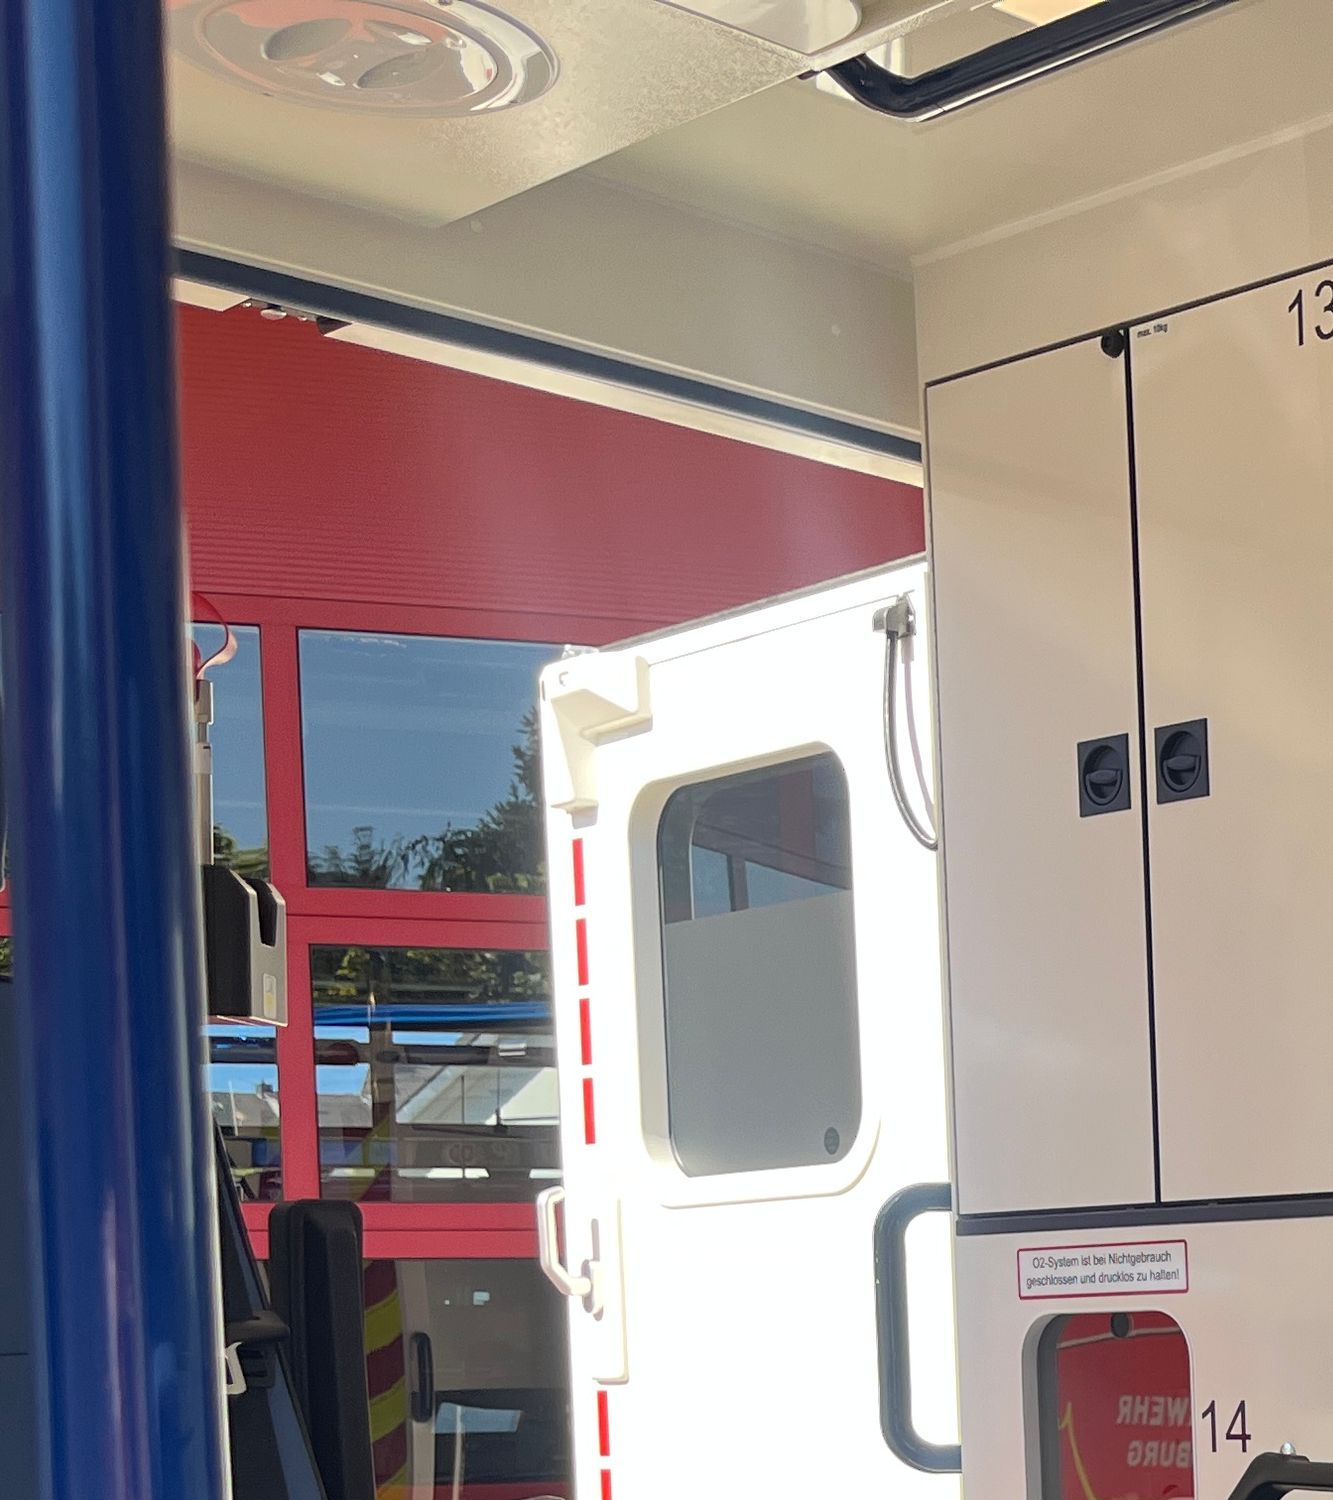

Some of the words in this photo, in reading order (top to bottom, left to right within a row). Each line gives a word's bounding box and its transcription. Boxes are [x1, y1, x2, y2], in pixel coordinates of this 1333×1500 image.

[1032, 1256, 1079, 1271] O2-System
[1081, 1255, 1091, 1266] ist
[1093, 1254, 1107, 1266] bei
[1108, 1250, 1172, 1266] Nichtgebrauch
[1026, 1273, 1078, 1289] geschlossen
[1080, 1273, 1096, 1284] und
[1098, 1270, 1134, 1284] drucklos
[1136, 1271, 1148, 1282] zu
[1150, 1269, 1180, 1281] halten!
[1201, 1400, 1252, 1453] 14
